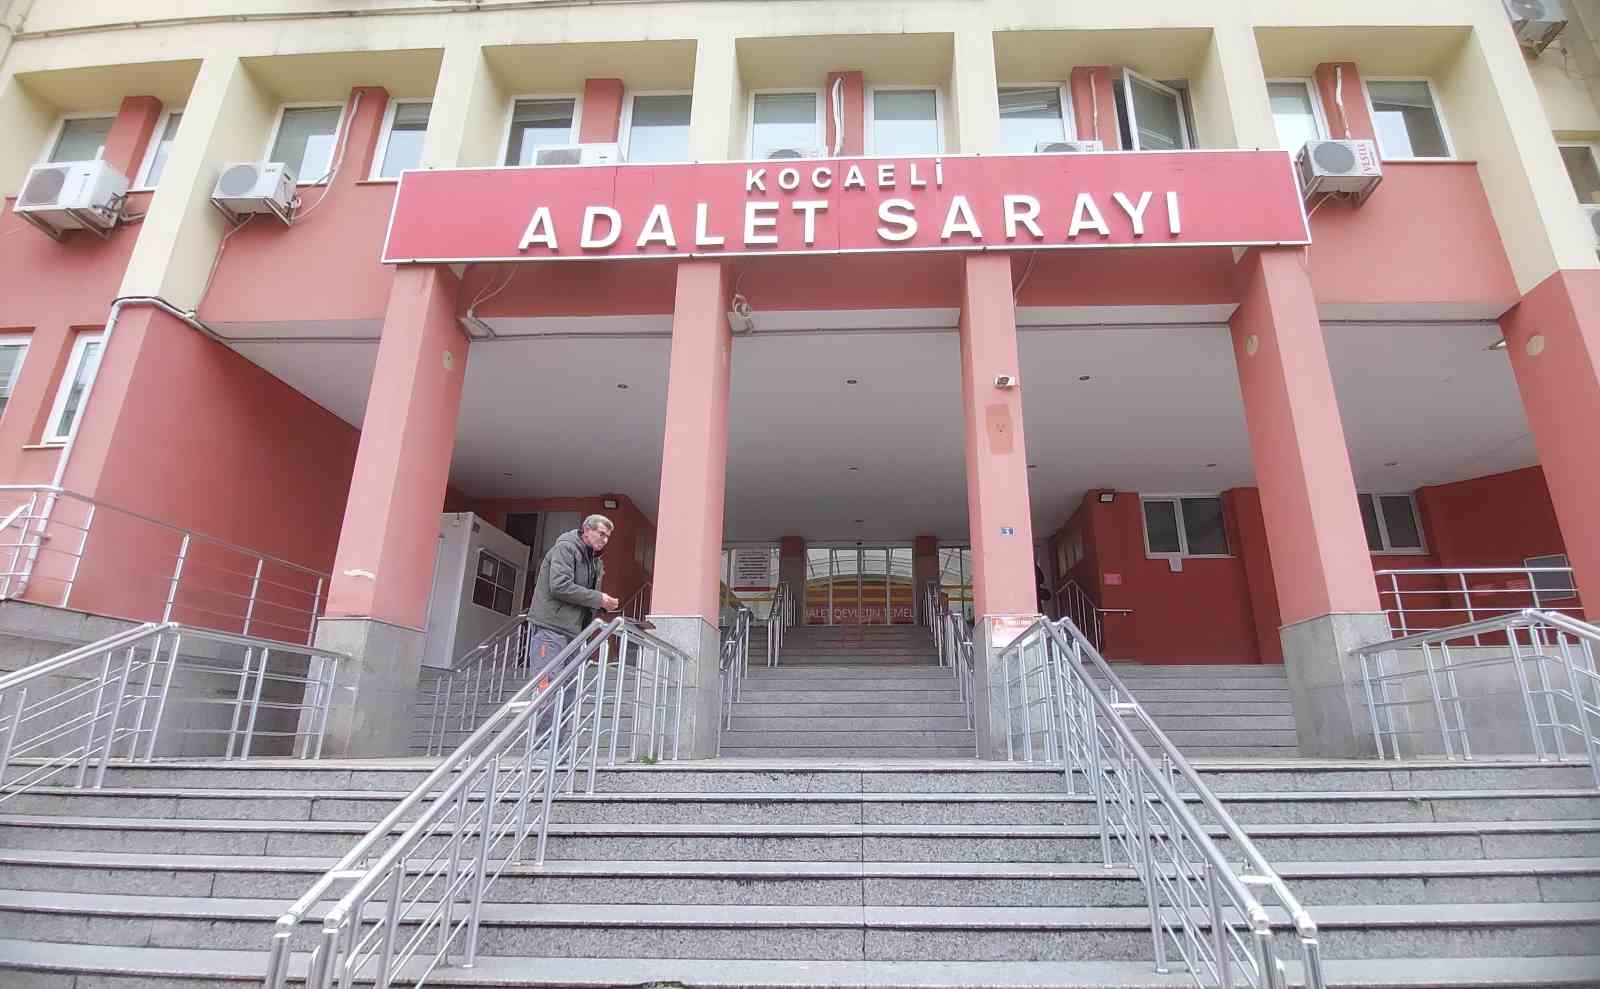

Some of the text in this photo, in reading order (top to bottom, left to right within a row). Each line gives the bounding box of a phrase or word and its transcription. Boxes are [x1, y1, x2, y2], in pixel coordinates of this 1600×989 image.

[745, 158, 944, 193] KOCAELİ
[518, 190, 1182, 251] ADALET SARAYI
